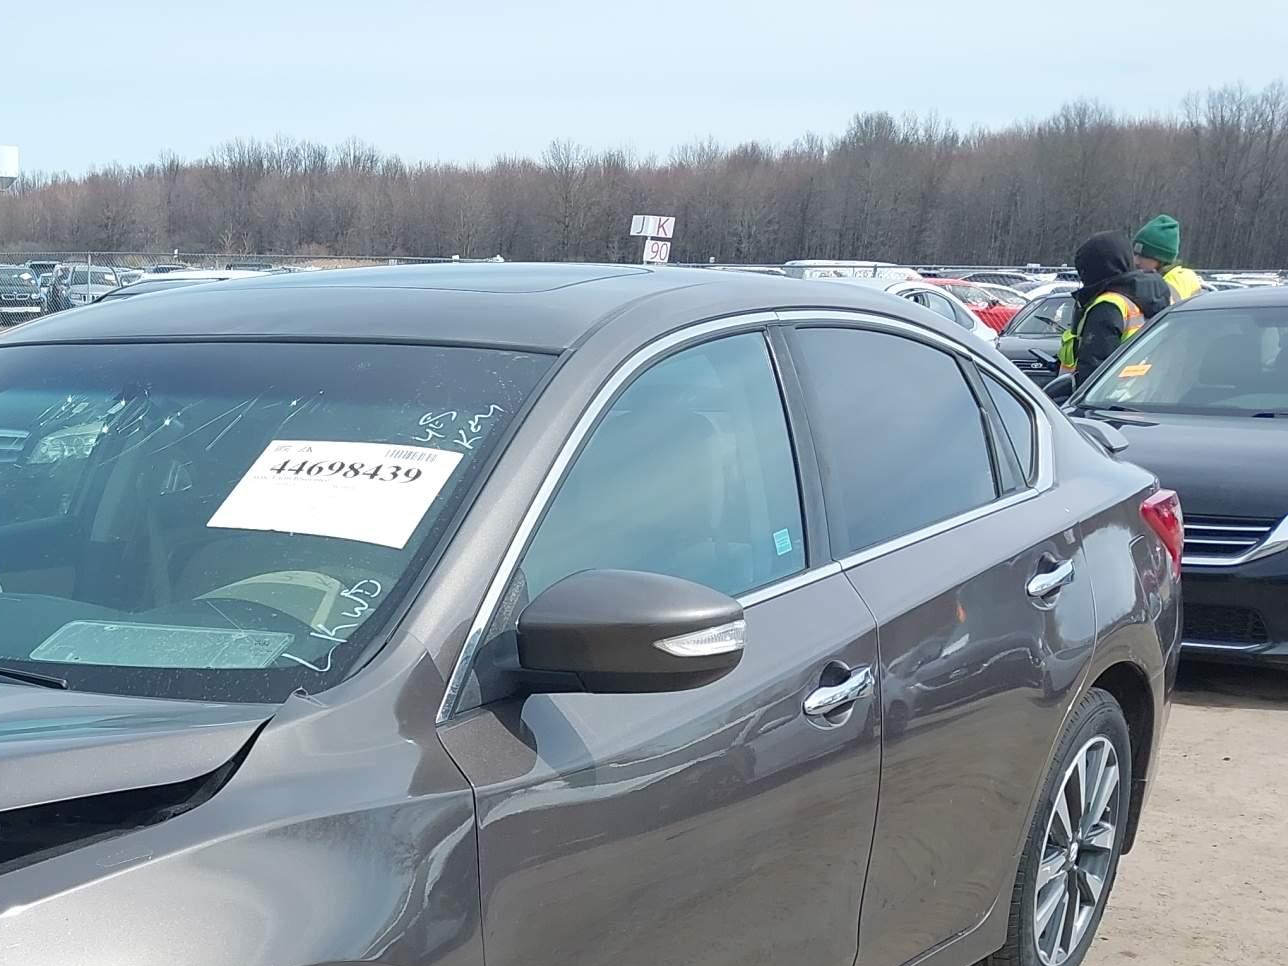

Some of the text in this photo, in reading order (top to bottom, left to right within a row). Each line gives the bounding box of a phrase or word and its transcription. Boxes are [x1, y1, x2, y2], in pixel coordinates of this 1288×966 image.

[657, 218, 669, 236] K
[650, 242, 669, 261] 90
[269, 459, 423, 484] 44698439
